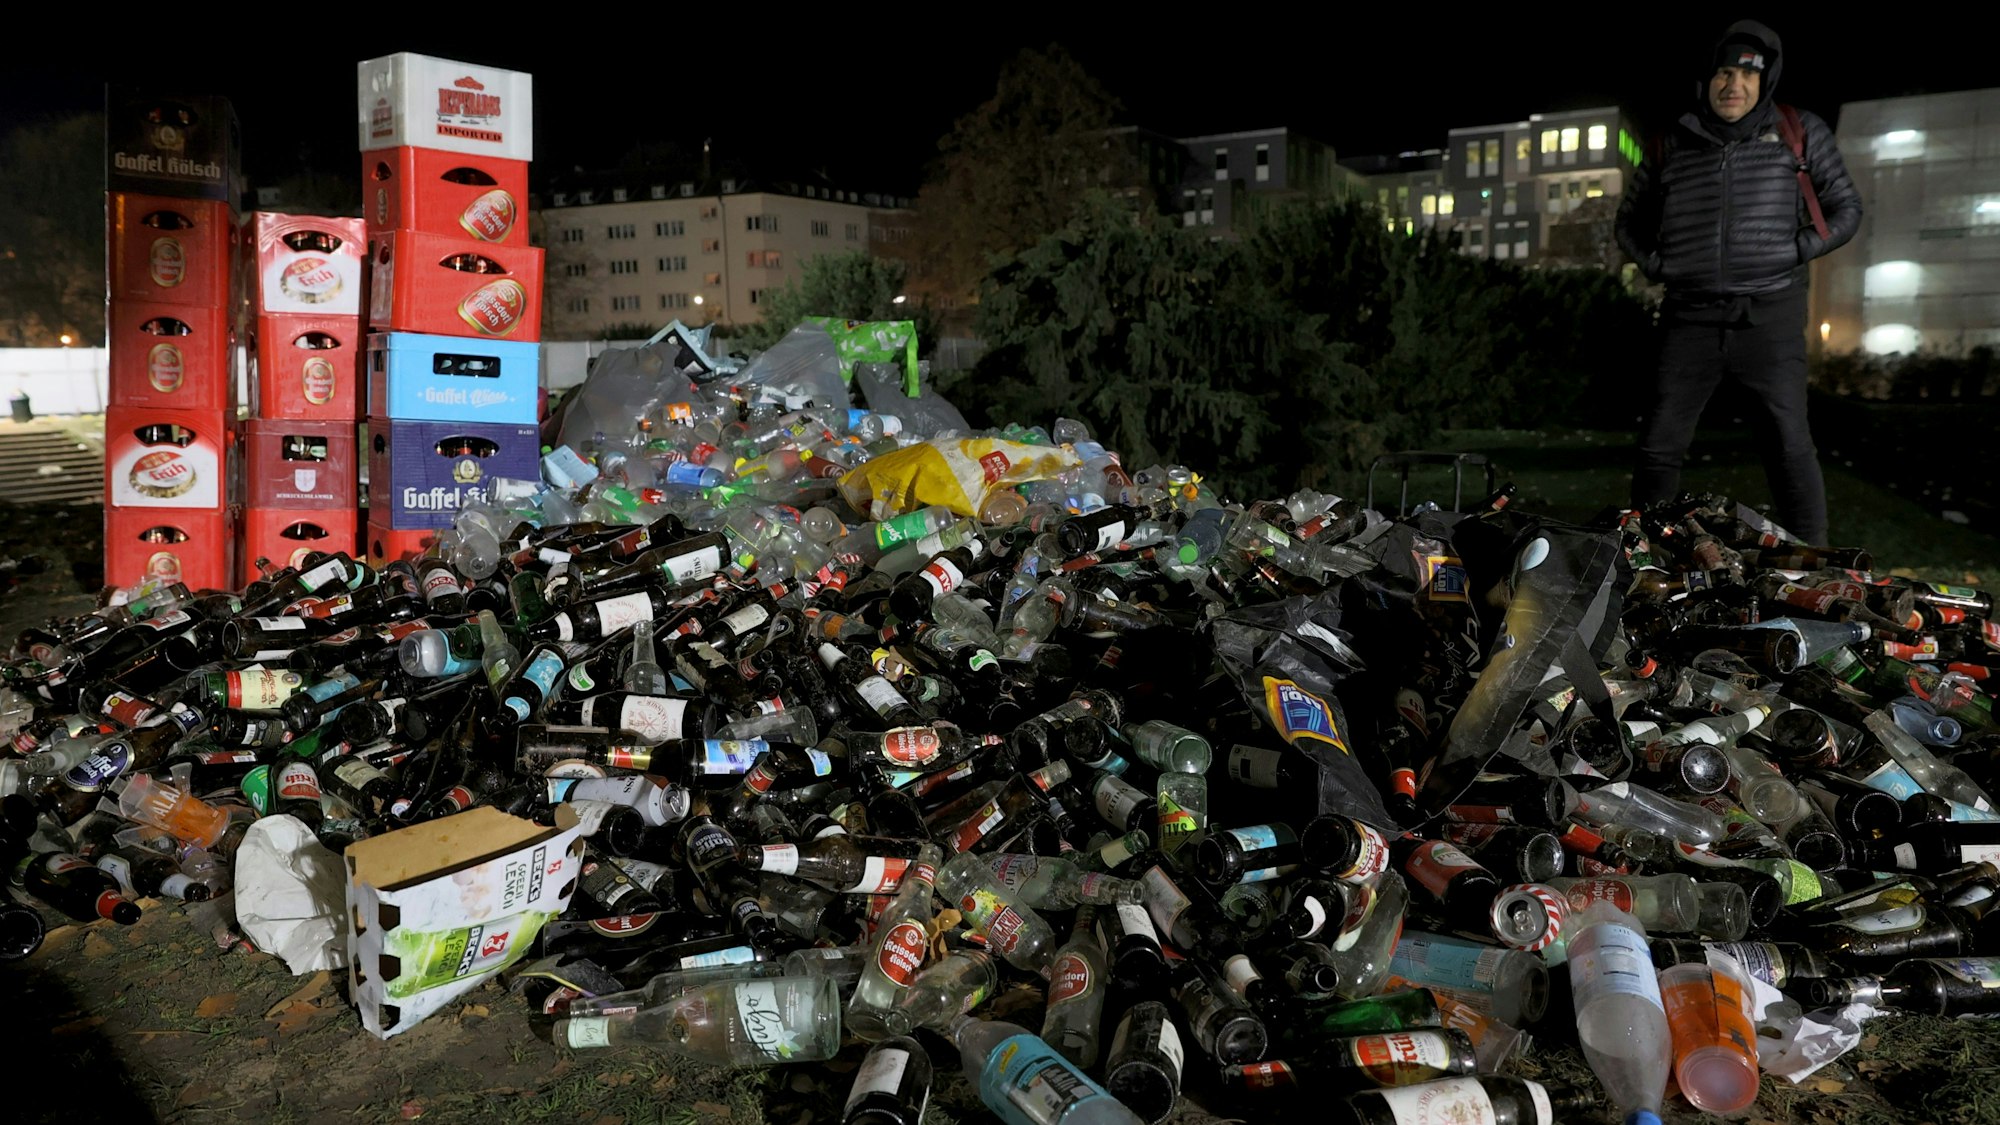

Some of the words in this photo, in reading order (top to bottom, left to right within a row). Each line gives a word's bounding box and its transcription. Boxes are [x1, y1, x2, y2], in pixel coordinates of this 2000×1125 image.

[1738, 52, 1765, 69] FIL
[438, 88, 501, 116] DESPERADOS
[438, 124, 502, 142] IMPORTED
[115, 152, 163, 173] Gaffel
[167, 157, 220, 179] Kölsch
[425, 387, 467, 404] Gaffel
[403, 487, 461, 510] Gaffel
[1437, 566, 1446, 592] ALDI
[1281, 690, 1322, 711] ALDI
[503, 860, 518, 910] LEMON
[515, 863, 528, 899] GREEN
[530, 850, 545, 903] BECK'S
[457, 926, 480, 977] BECK'S
